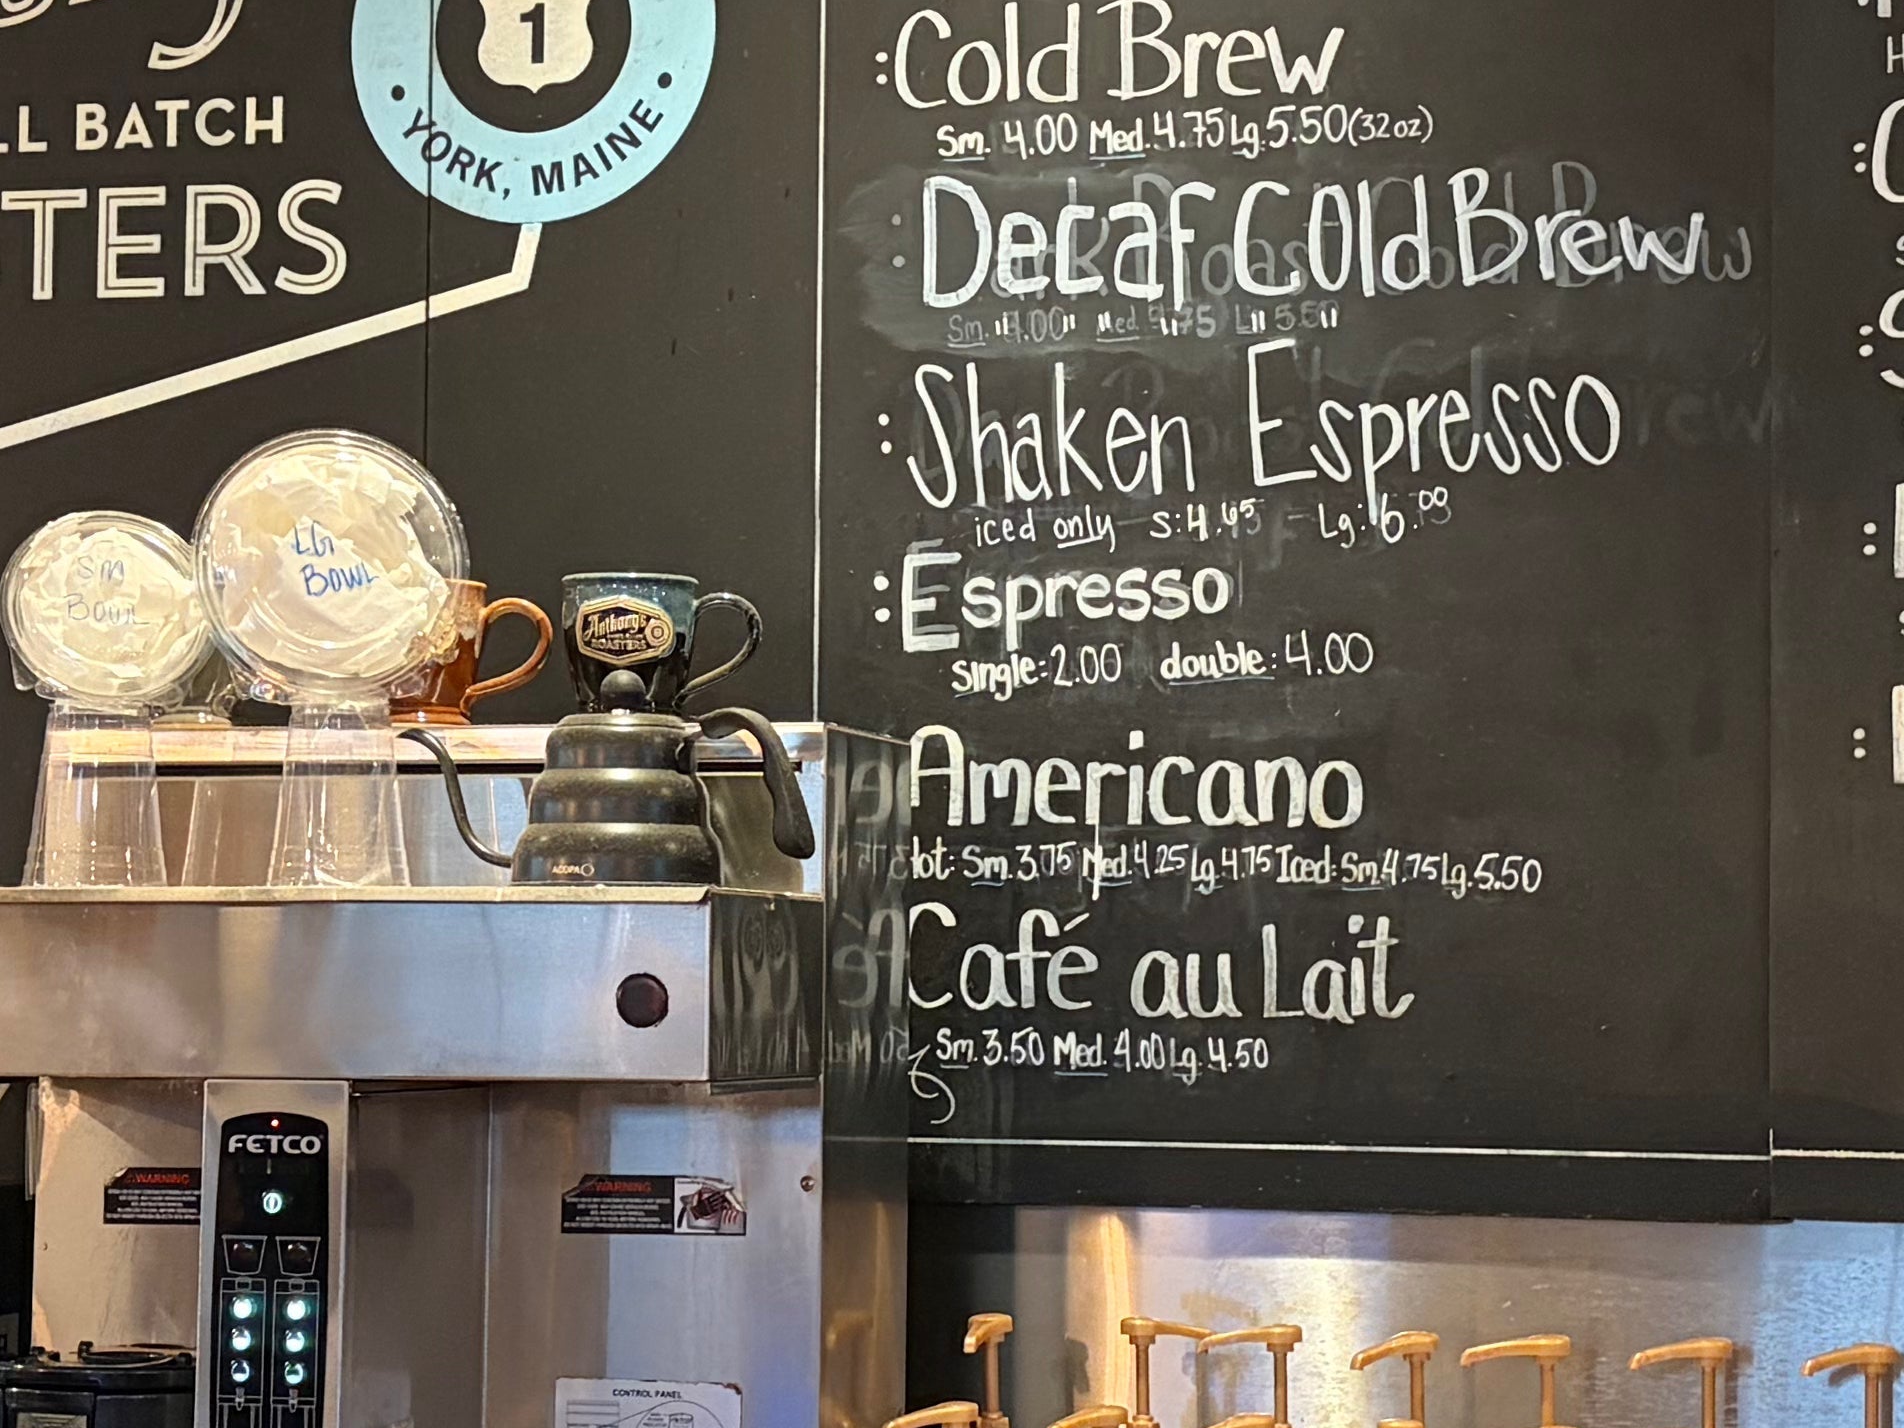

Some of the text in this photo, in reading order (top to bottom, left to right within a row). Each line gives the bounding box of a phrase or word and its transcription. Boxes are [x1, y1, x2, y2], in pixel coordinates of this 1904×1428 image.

[520, 0, 549, 65] 1
[895, 2, 1079, 108] Cold
[76, 96, 283, 150] BATCH
[398, 94, 667, 199] YORK, MAINE
[922, 172, 1219, 309] Decaf
[1447, 166, 1705, 288] Brew
[906, 339, 1621, 517] Shaken Espresso
[299, 561, 380, 597] BOWL
[899, 547, 1232, 655] Espresso
[908, 723, 1367, 832] Americano
[907, 899, 1414, 1024] Café au Lait
[227, 1134, 322, 1155] FETCO
[612, 1387, 682, 1400] CONTROL PANEL
